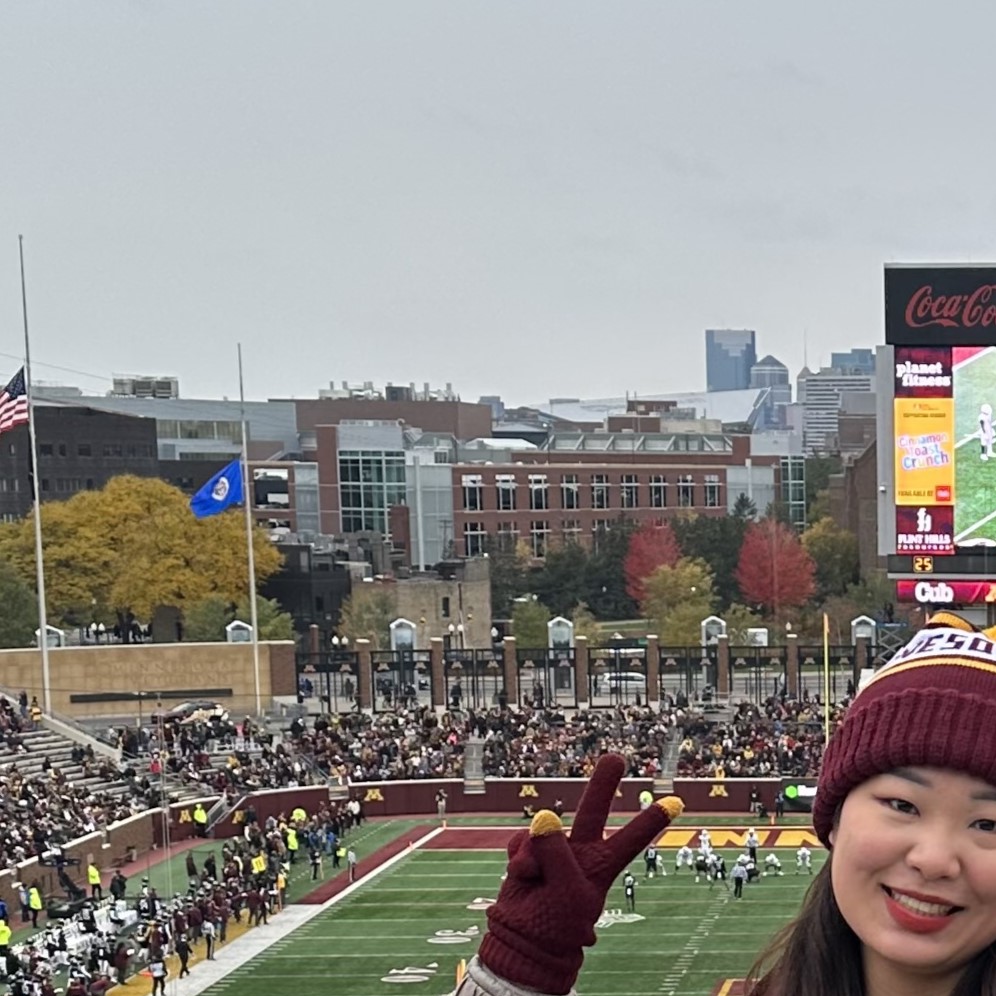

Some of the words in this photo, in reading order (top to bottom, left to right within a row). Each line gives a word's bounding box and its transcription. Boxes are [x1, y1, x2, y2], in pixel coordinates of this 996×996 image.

[899, 433, 948, 447] Cinnamon
[903, 451, 949, 469] Crunch
[914, 557, 932, 571] 25
[915, 581, 955, 603] Cub
